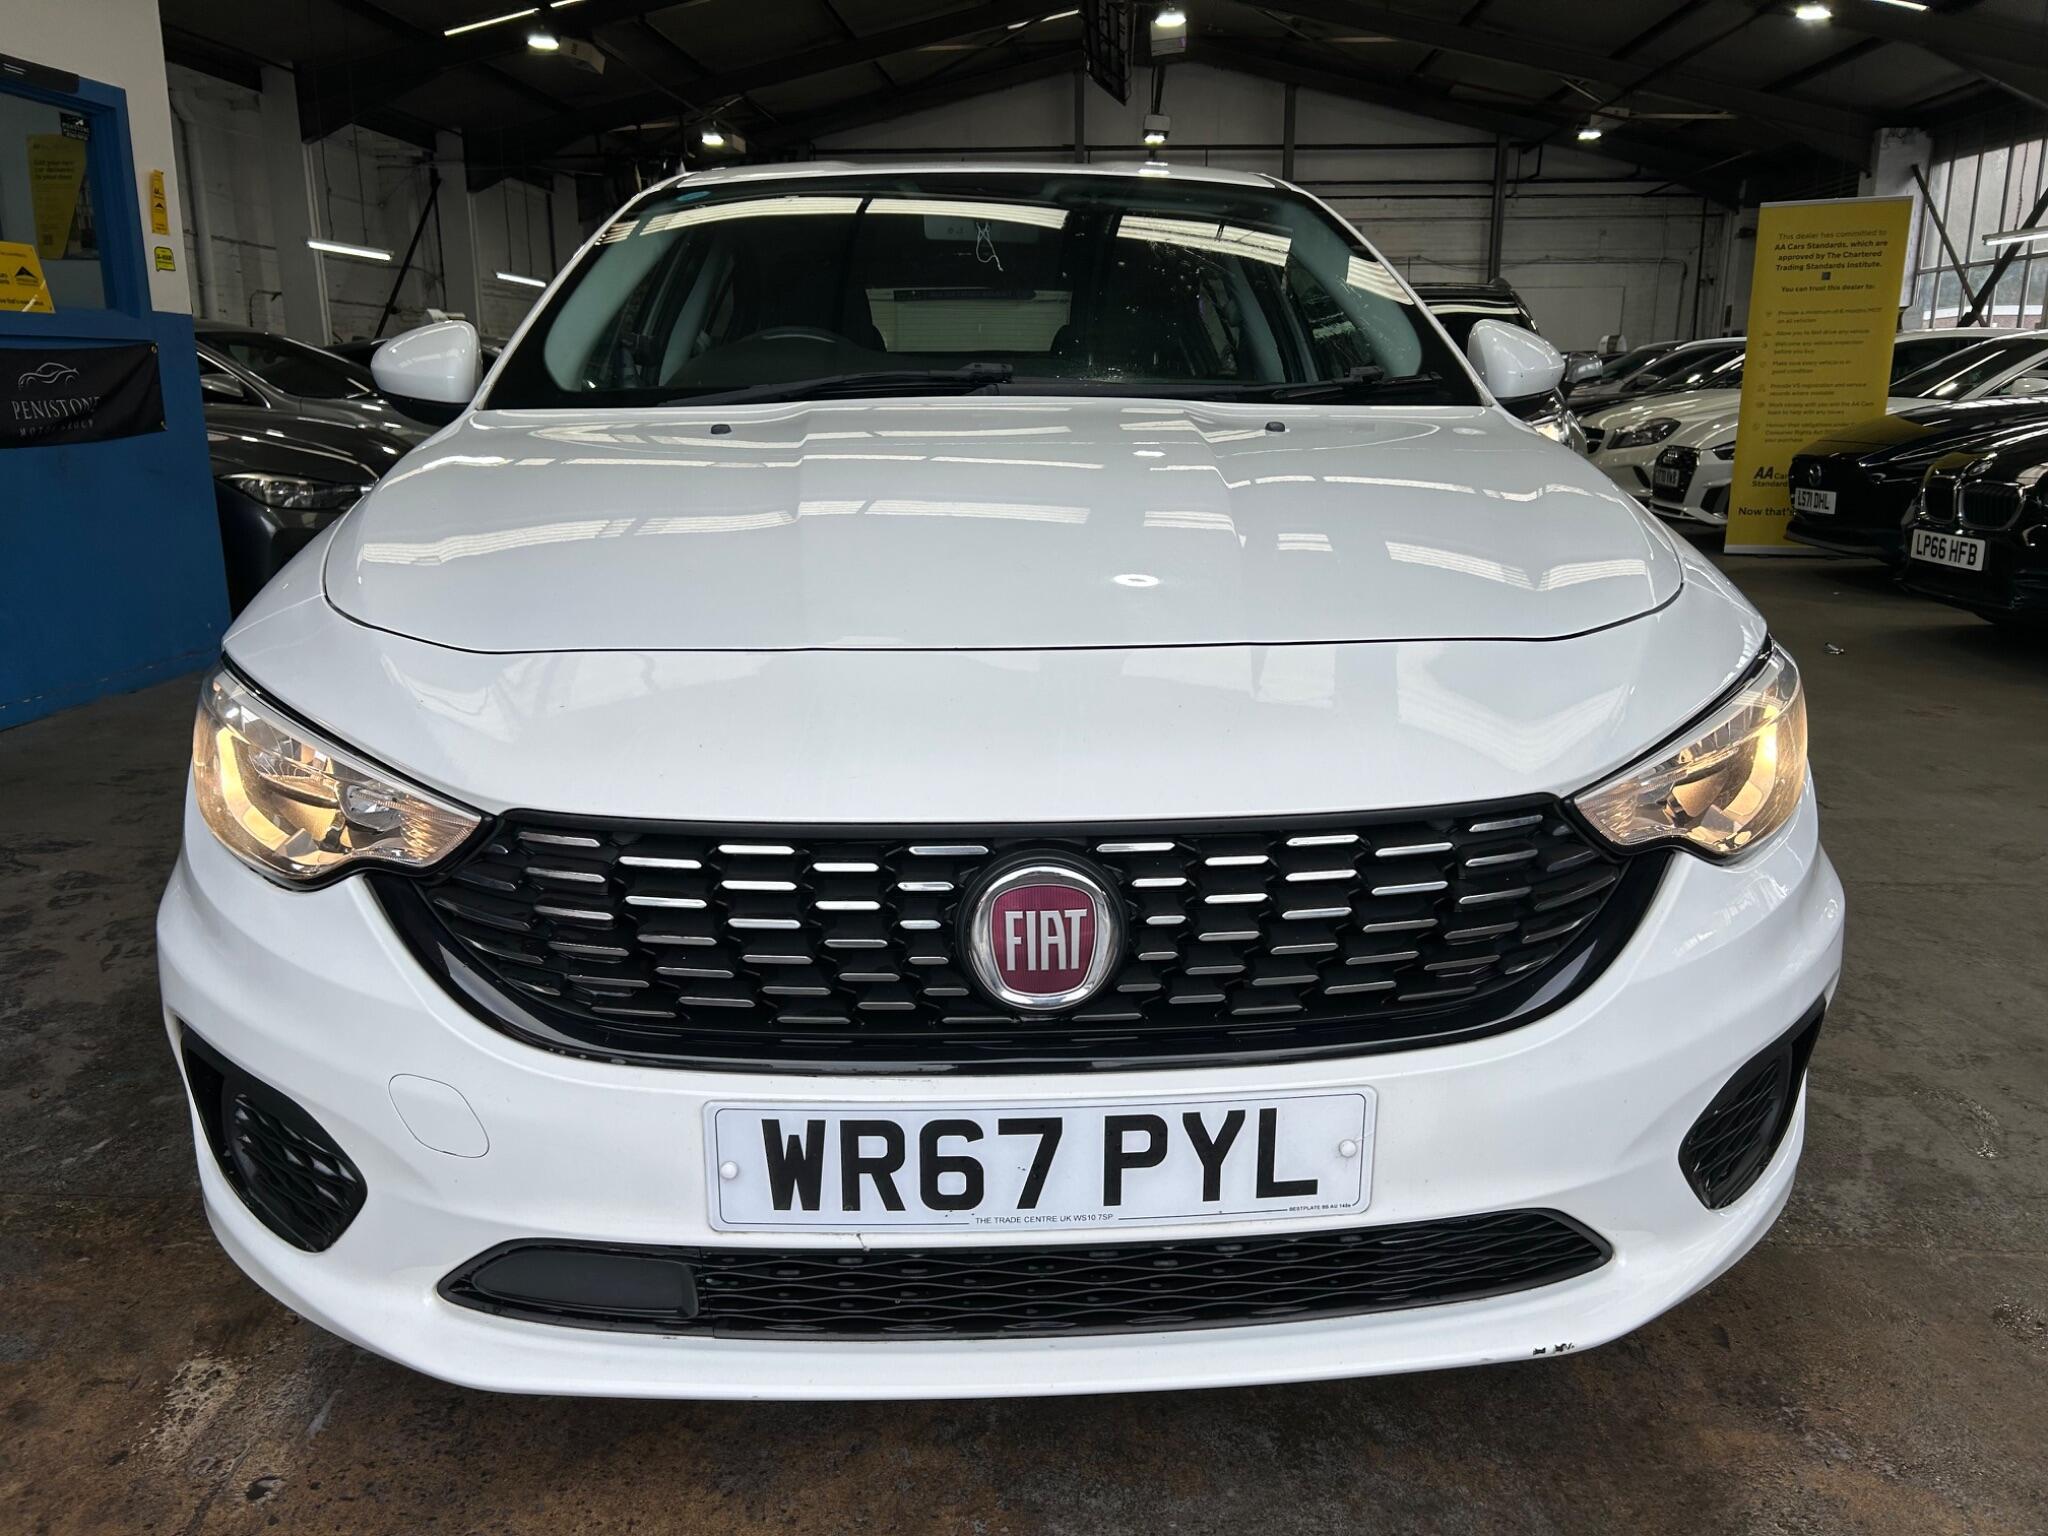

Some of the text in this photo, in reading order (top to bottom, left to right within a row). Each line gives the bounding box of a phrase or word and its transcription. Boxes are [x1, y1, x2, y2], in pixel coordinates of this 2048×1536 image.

[1795, 232, 1818, 240] dealer
[1821, 231, 1834, 239] has
[1836, 230, 1877, 238] committed
[1851, 240, 1874, 248] which
[1778, 253, 1814, 262] approved
[1815, 253, 1826, 261] by
[1843, 250, 1882, 258] Chartered
[1776, 264, 1804, 272] Trading
[1805, 262, 1845, 270] Standards
[1753, 466, 1774, 480] AA
[1813, 492, 1829, 510] DHL
[1738, 507, 1762, 516] Now
[1916, 534, 1978, 566] LP66 HFB
[1005, 908, 1088, 971] FIAT
[761, 1108, 1319, 1212] WR67 PYL
[994, 1216, 1022, 1224] TRADE
[1024, 1215, 1057, 1223] CENTRE
[1073, 1214, 1096, 1222] WS10
[1098, 1213, 1114, 1221] 7SP
